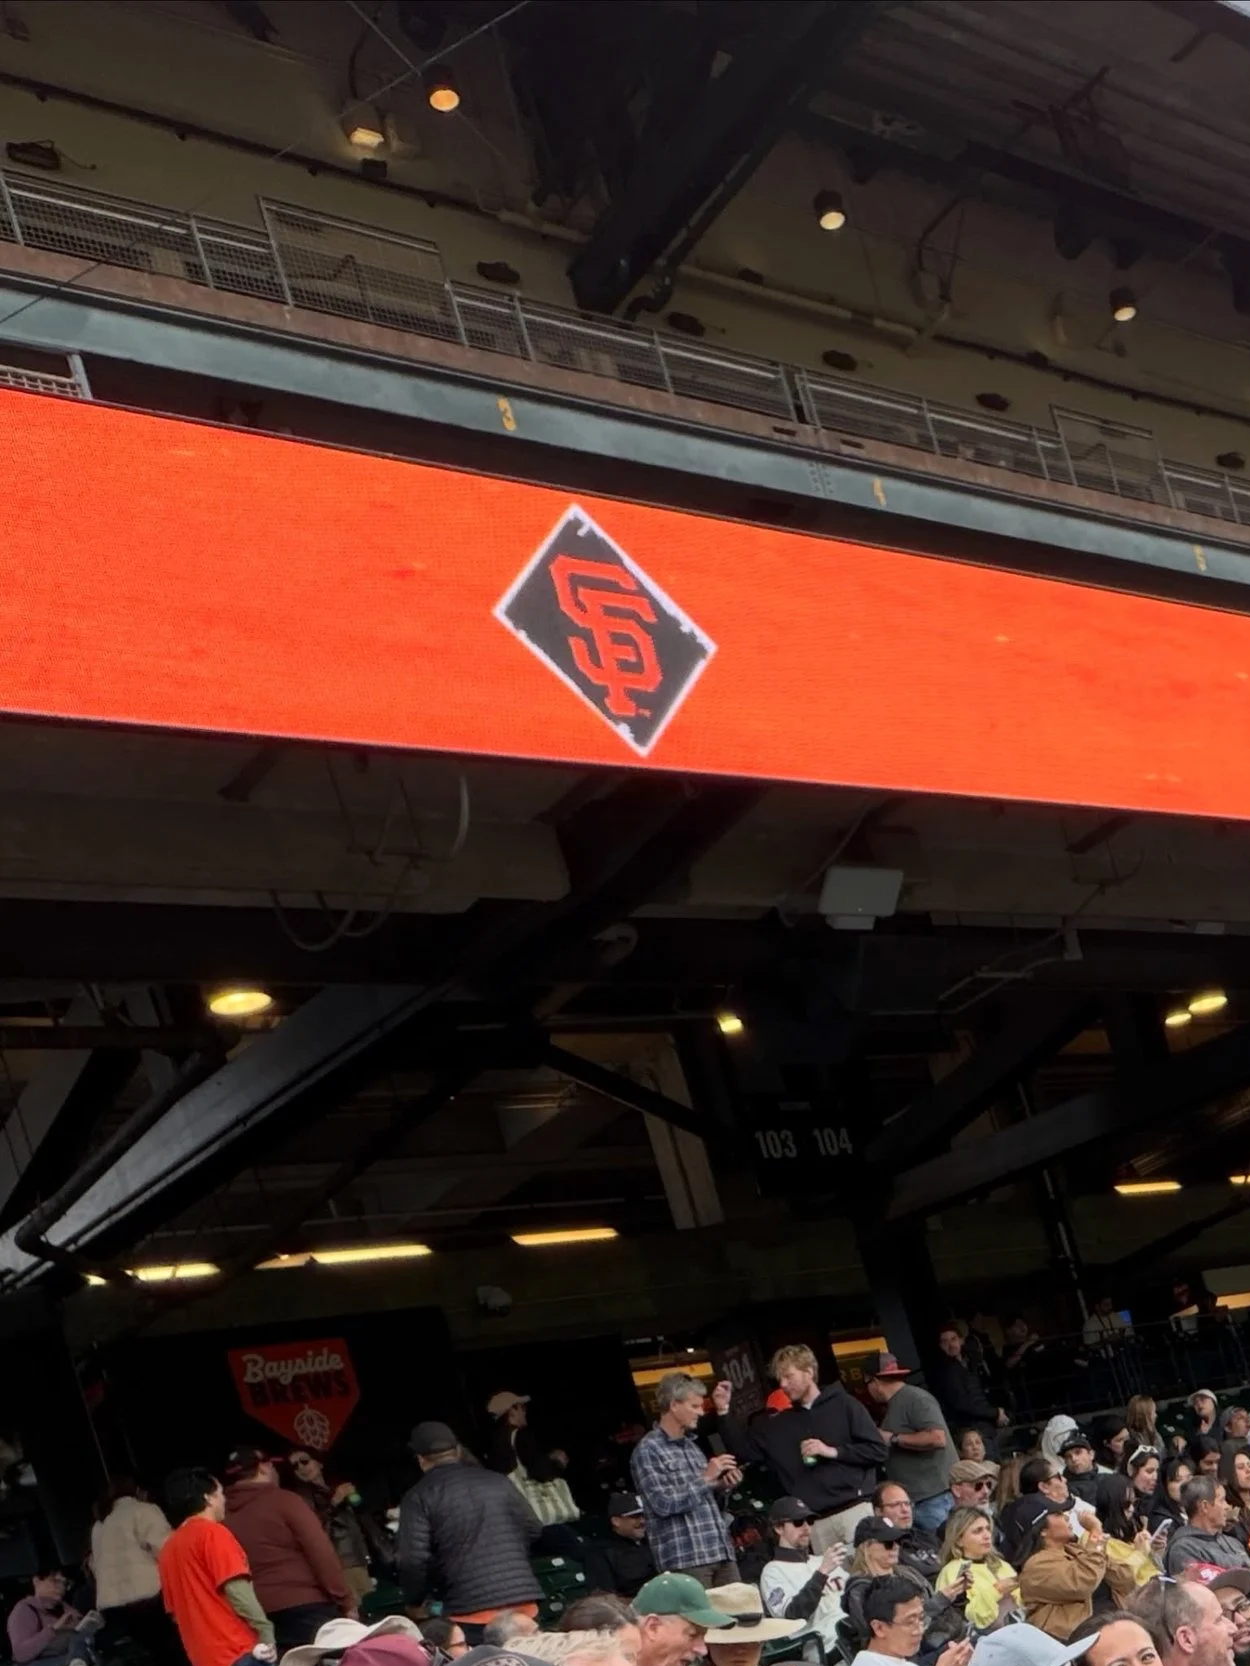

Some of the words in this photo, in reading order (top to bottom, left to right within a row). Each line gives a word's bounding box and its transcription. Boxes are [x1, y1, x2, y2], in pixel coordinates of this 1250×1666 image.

[497, 396, 516, 431] 3
[549, 553, 664, 718] SF
[754, 1130, 797, 1158] 103
[812, 1127, 853, 1156] 104
[242, 1347, 344, 1385] Bayside
[722, 1353, 755, 1390] 104
[248, 1370, 351, 1408] BREWS
